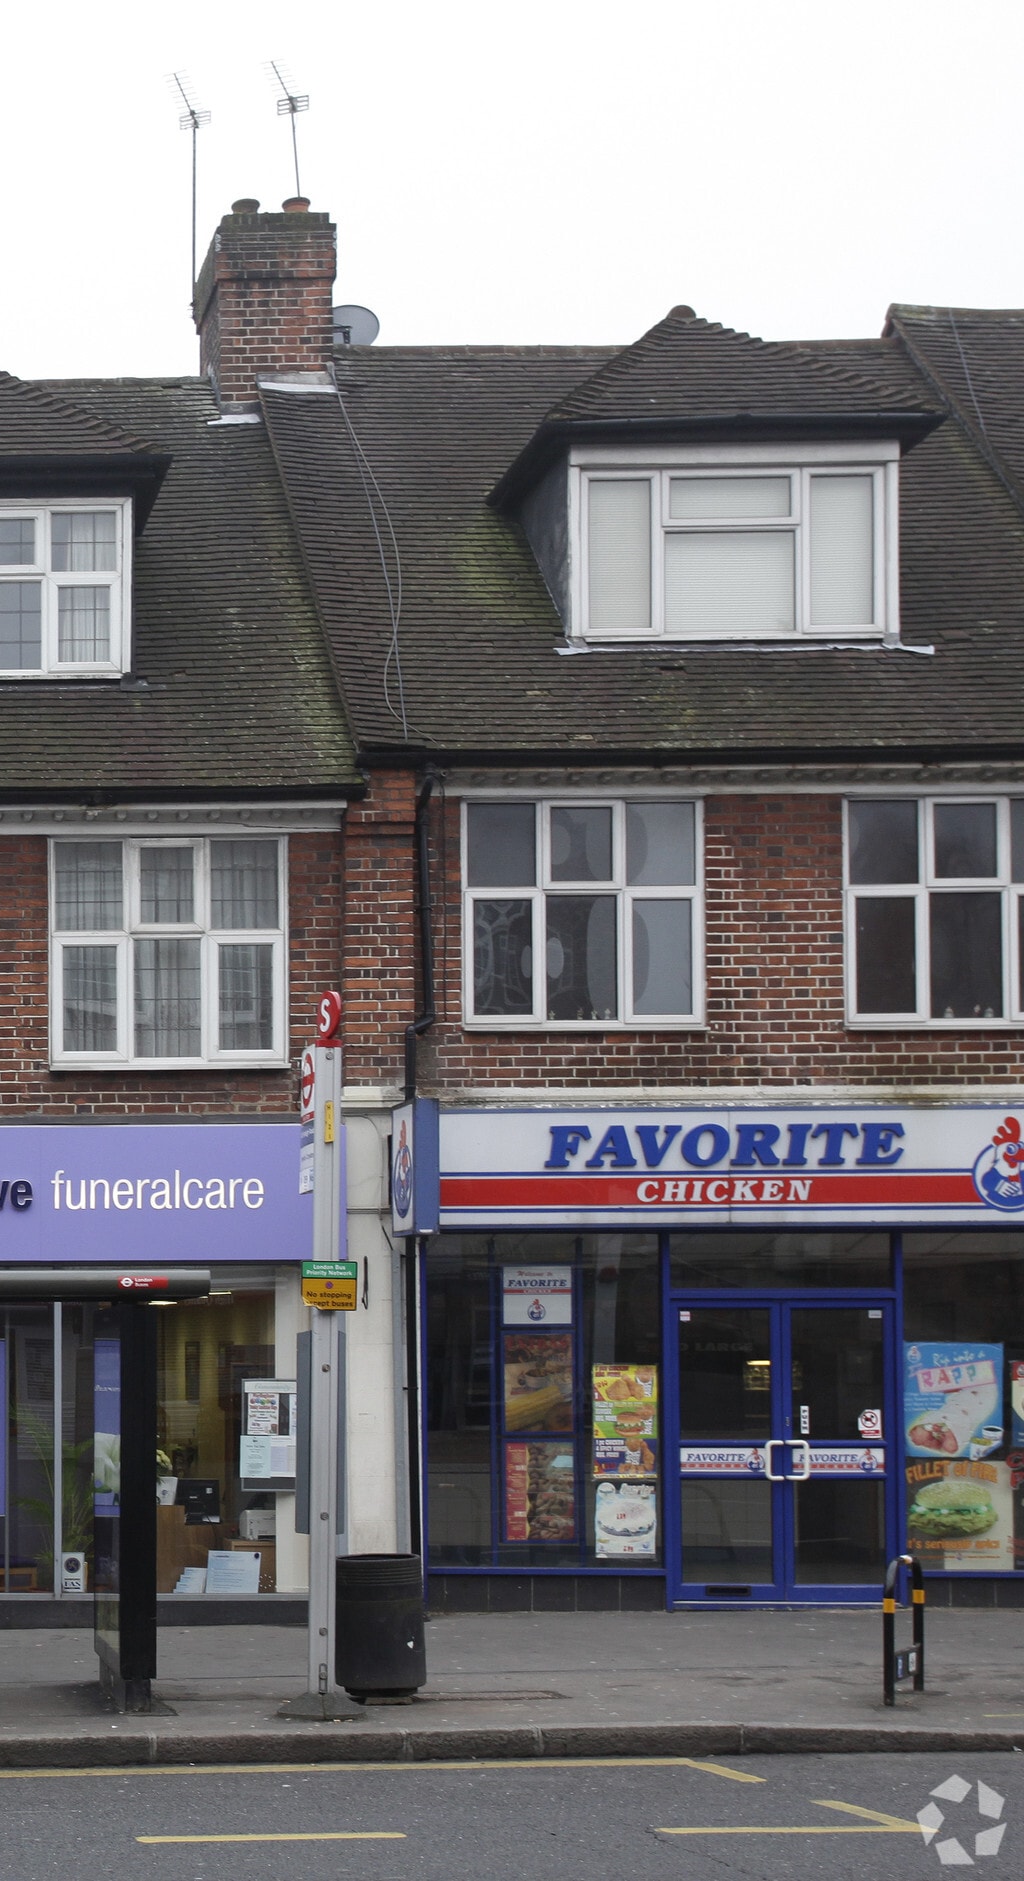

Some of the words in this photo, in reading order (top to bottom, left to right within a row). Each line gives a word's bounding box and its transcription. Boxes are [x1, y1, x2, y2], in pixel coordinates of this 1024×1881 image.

[544, 1122, 905, 1168] FAVORITE
[51, 1169, 265, 1211] funeralcare
[636, 1179, 813, 1203] CHICKEN
[306, 1269, 327, 1277] Priority
[508, 1279, 568, 1287] FAVORITE
[319, 1291, 352, 1300] stopping
[687, 1453, 746, 1462] FAVORITE
[905, 1460, 951, 1484] FILLET
[953, 1460, 969, 1477] of
